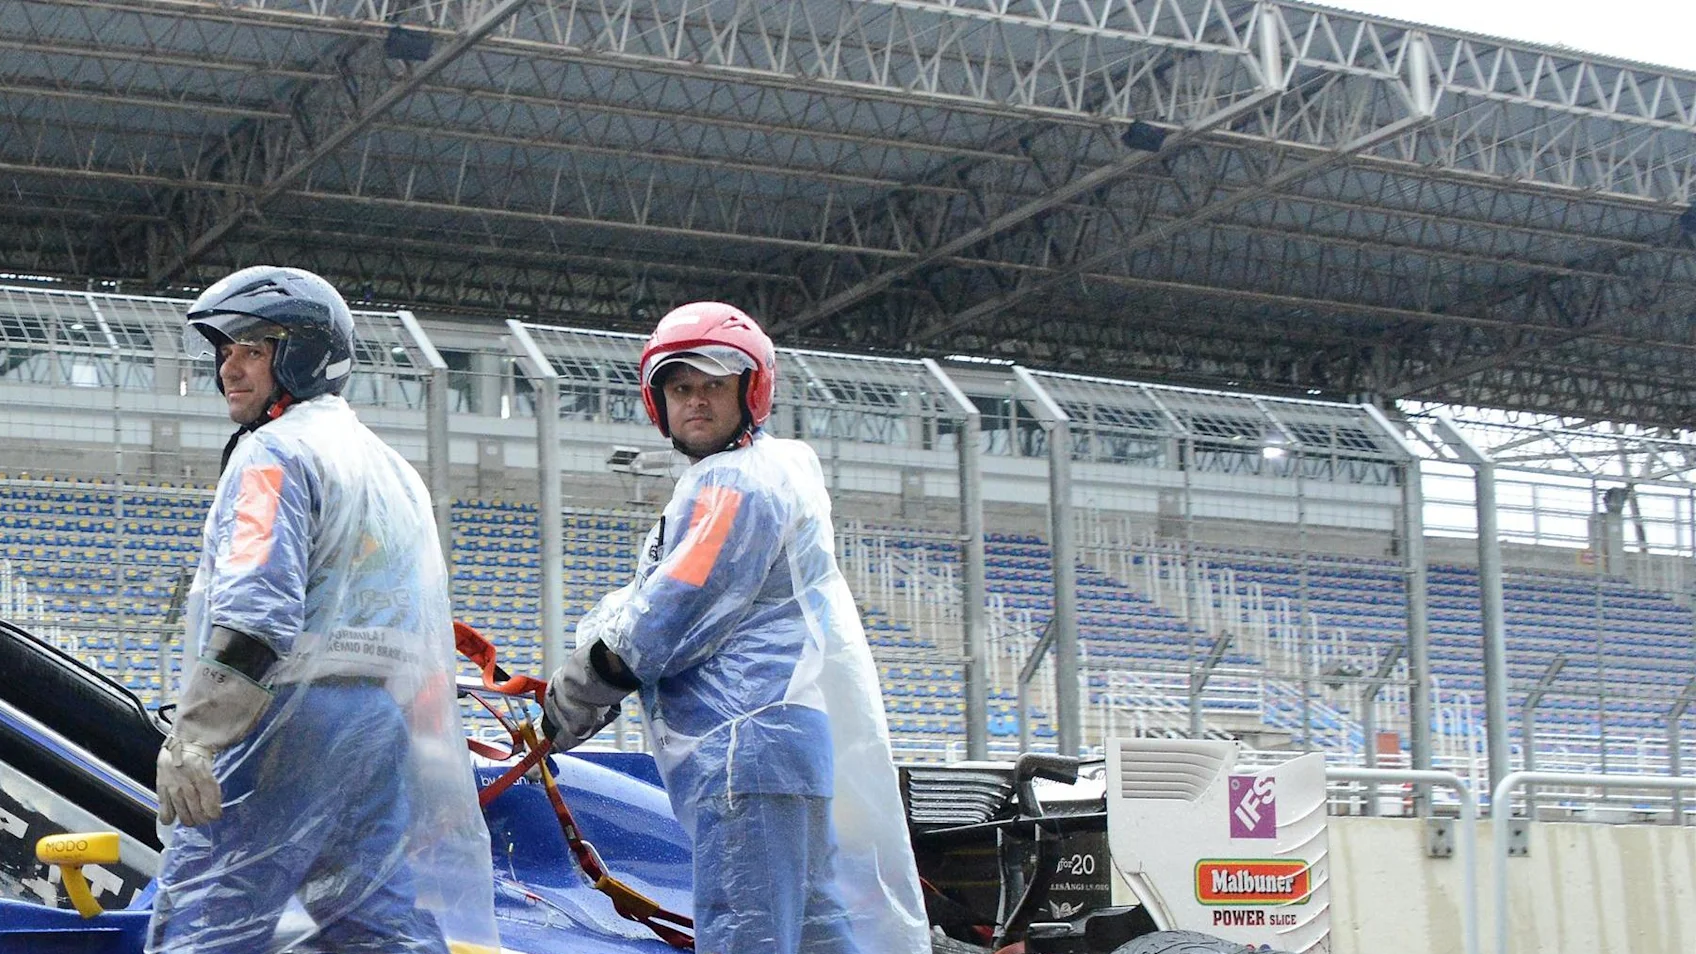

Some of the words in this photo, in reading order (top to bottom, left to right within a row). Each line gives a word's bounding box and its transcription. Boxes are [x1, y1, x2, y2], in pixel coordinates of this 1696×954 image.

[1234, 775, 1276, 832] IFS
[45, 840, 89, 853] MODO
[1211, 869, 1296, 895] Malbuner
[1213, 910, 1265, 926] POWER
[1269, 914, 1296, 926] SLICE
